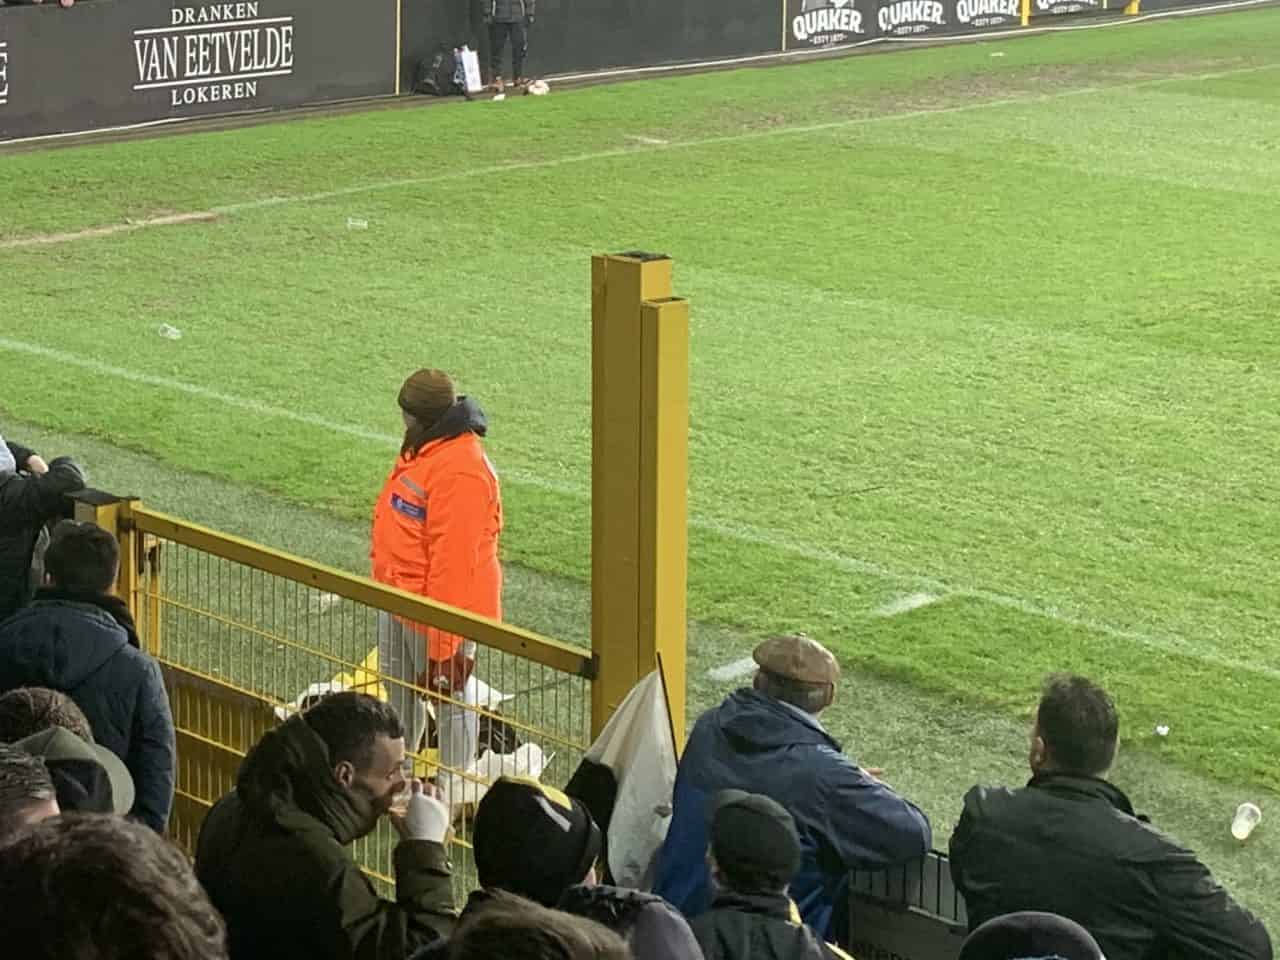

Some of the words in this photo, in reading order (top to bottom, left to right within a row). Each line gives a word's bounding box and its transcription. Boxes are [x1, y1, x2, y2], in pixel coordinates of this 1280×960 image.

[171, 2, 259, 25] DRANKEN
[792, 7, 863, 41] QUAKER
[878, 0, 943, 32] QUAKER
[133, 38, 180, 82] VAN
[182, 26, 294, 79] EETVELDE
[171, 82, 258, 106] LOKEREN
